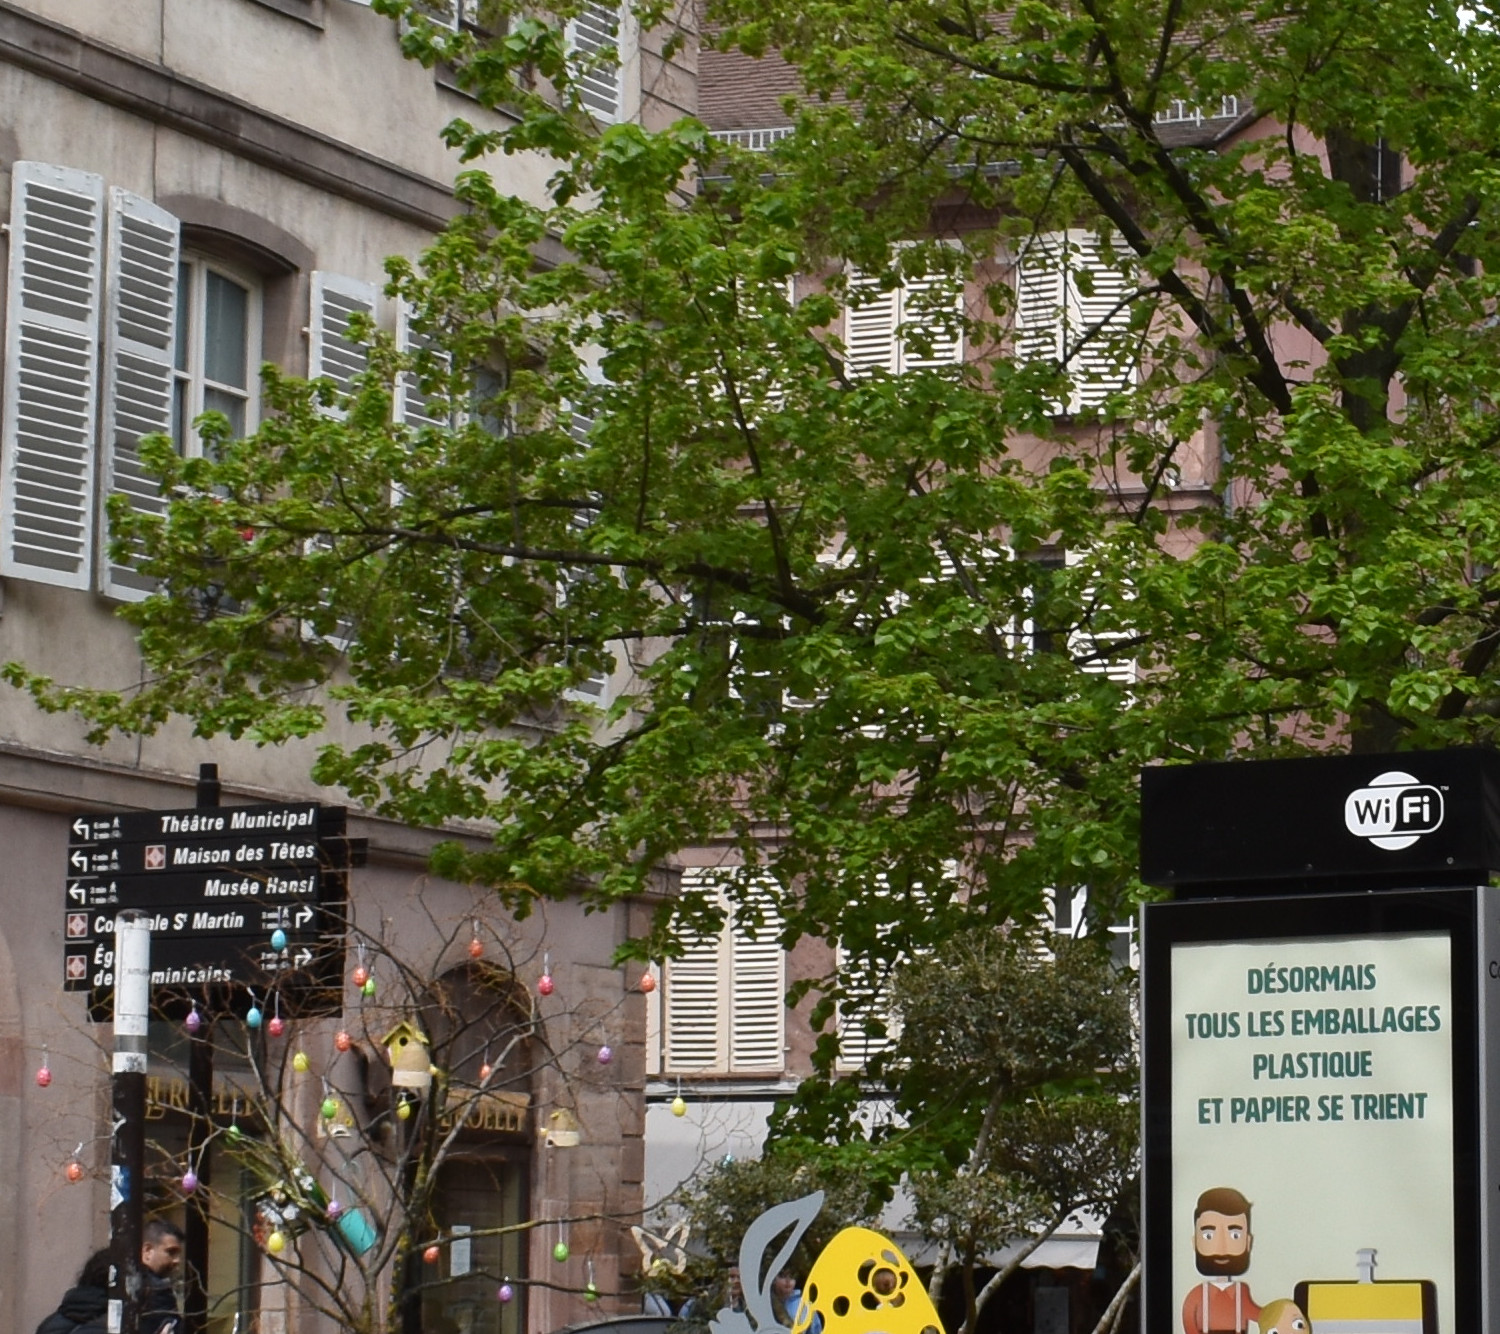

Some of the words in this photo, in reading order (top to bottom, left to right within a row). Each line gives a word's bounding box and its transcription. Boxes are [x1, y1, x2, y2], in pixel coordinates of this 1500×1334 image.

[161, 815, 224, 833] Théâtre
[230, 808, 314, 830] Municipal
[173, 847, 230, 865] Maison
[235, 845, 263, 862] des
[270, 842, 315, 860] Têtes
[204, 877, 259, 897] Musée
[265, 876, 315, 895] Hansi
[193, 912, 244, 929] Martin
[94, 969, 116, 986] de
[151, 966, 232, 984] minicains
[1247, 961, 1377, 995] DÉSORMAIS
[1186, 1013, 1241, 1040] TOUS
[1248, 1011, 1285, 1038] LES
[1291, 1004, 1441, 1035] EMBALLAGES
[1253, 1051, 1373, 1080] PLASTIQUE
[1198, 1098, 1224, 1124] ET
[1231, 1094, 1311, 1123] PAPIER
[1317, 1094, 1344, 1121] SE
[1351, 1092, 1428, 1120] TRIENT
